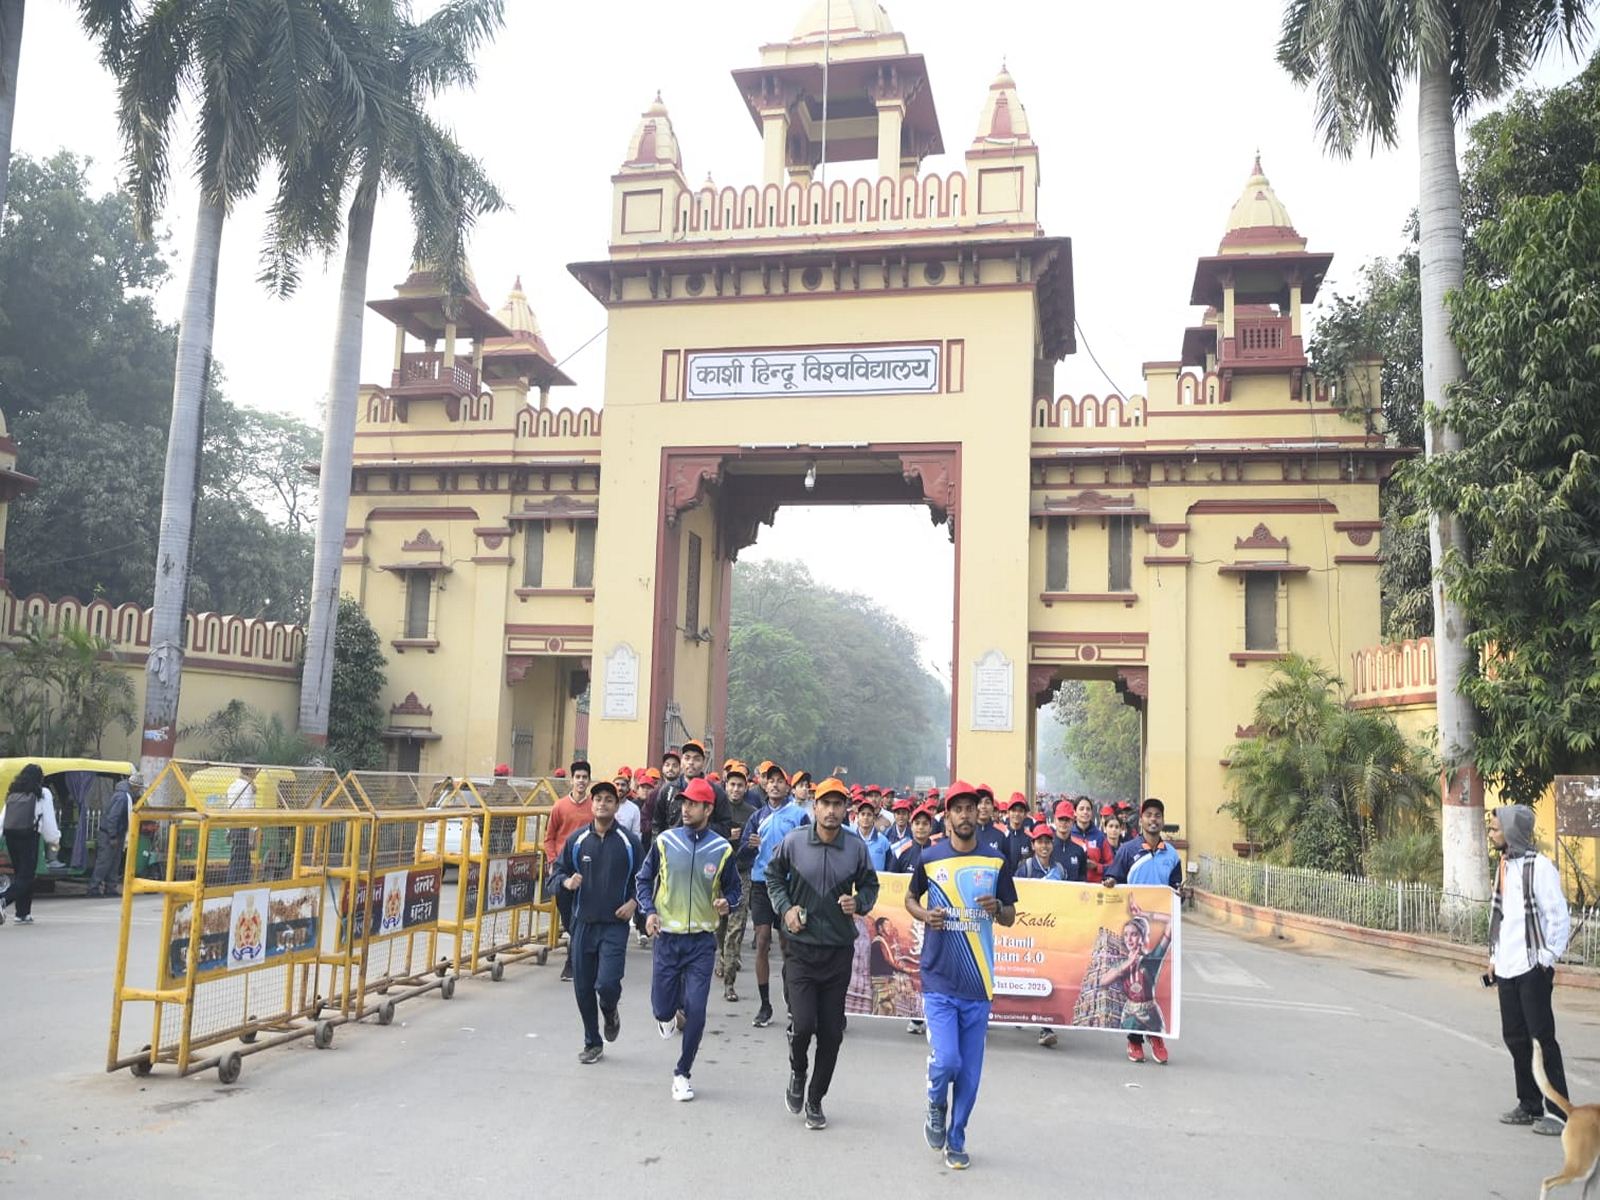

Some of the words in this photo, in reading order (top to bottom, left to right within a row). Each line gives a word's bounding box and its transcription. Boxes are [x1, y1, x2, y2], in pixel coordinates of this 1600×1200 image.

[696, 359, 744, 385] काशी
[750, 357, 798, 390] हिन्दू
[802, 353, 931, 384] विश्वविद्यालय
[414, 874, 435, 894] उत्तर
[964, 908, 989, 921] WELFARE
[1015, 911, 1057, 928] Kashi
[943, 920, 981, 932] FOUNDATION
[1023, 951, 1044, 964] 4.0
[1009, 982, 1026, 990] Dec.
